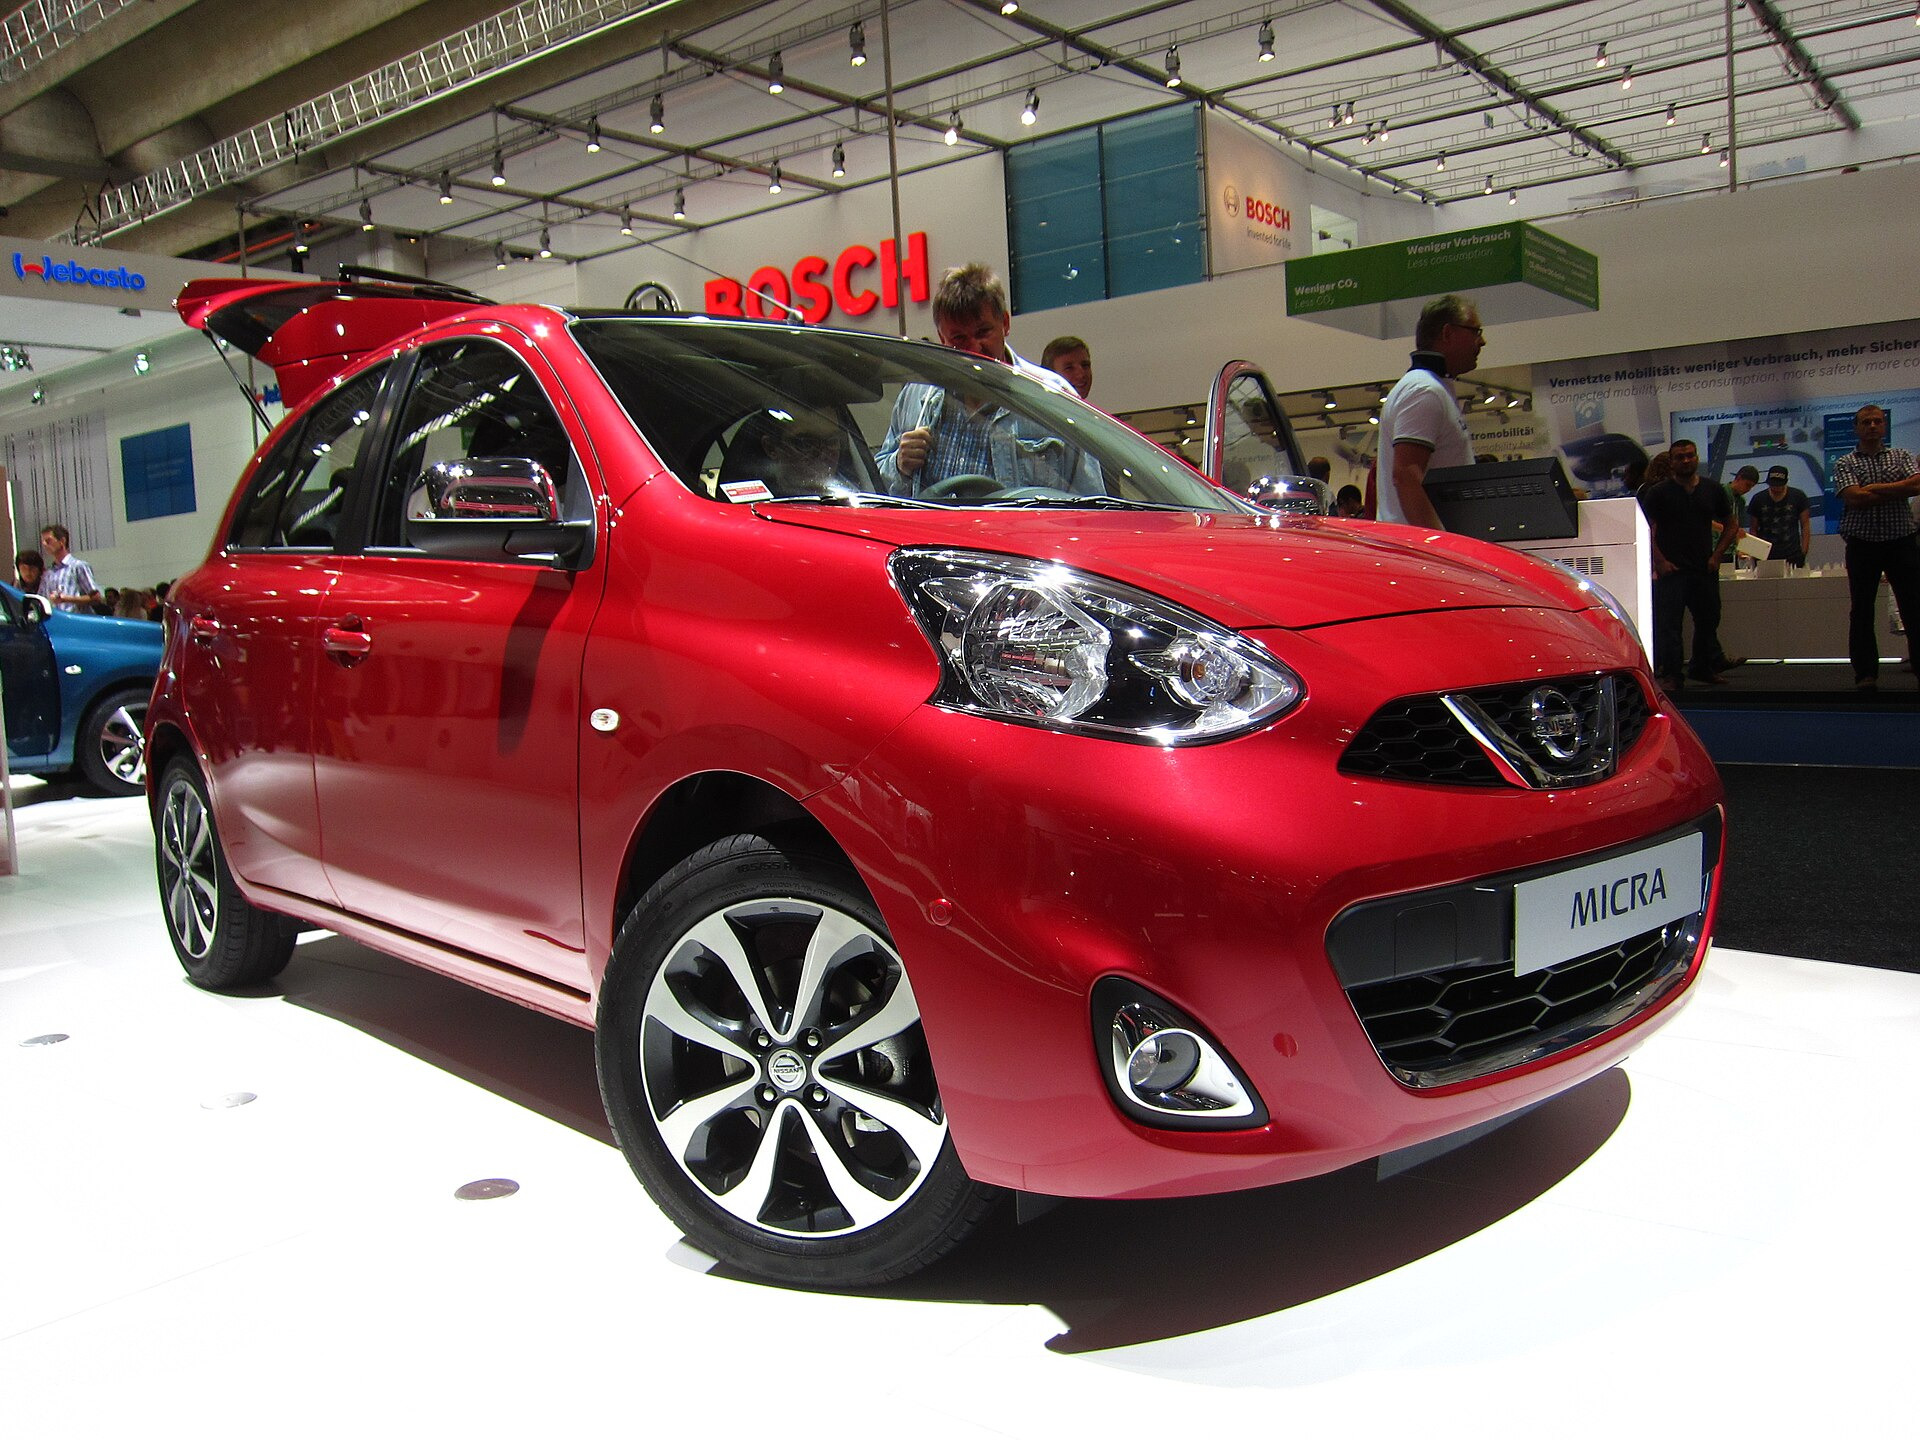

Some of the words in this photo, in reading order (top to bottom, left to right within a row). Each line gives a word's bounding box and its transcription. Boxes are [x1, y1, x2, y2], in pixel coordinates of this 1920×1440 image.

[1246, 196, 1290, 231] BOSCH
[1247, 226, 1272, 244] Invented
[1407, 240, 1452, 255] Weniger
[1453, 229, 1512, 247] Verbrauch
[13, 252, 146, 291] Webasto
[1408, 257, 1428, 269] Less
[1430, 247, 1493, 265] consumption
[704, 231, 931, 324] BOSCH
[1294, 281, 1336, 296] Weniger
[1549, 373, 1611, 389] Vernetzte
[1614, 364, 1681, 382] Mobilität:
[1684, 357, 1741, 376] weniger
[1743, 348, 1824, 367] Verbrauch,
[1826, 343, 1867, 358] mehr
[1869, 338, 1920, 354] Sicher
[1550, 386, 1612, 404] Connected
[1613, 381, 1664, 399] mobility:
[1667, 381, 1692, 393] less
[1693, 372, 1780, 390] consumption,
[1783, 367, 1816, 380] more
[1818, 362, 1862, 379] safety,
[1865, 358, 1901, 371] more
[1571, 867, 1667, 929] MICRA
